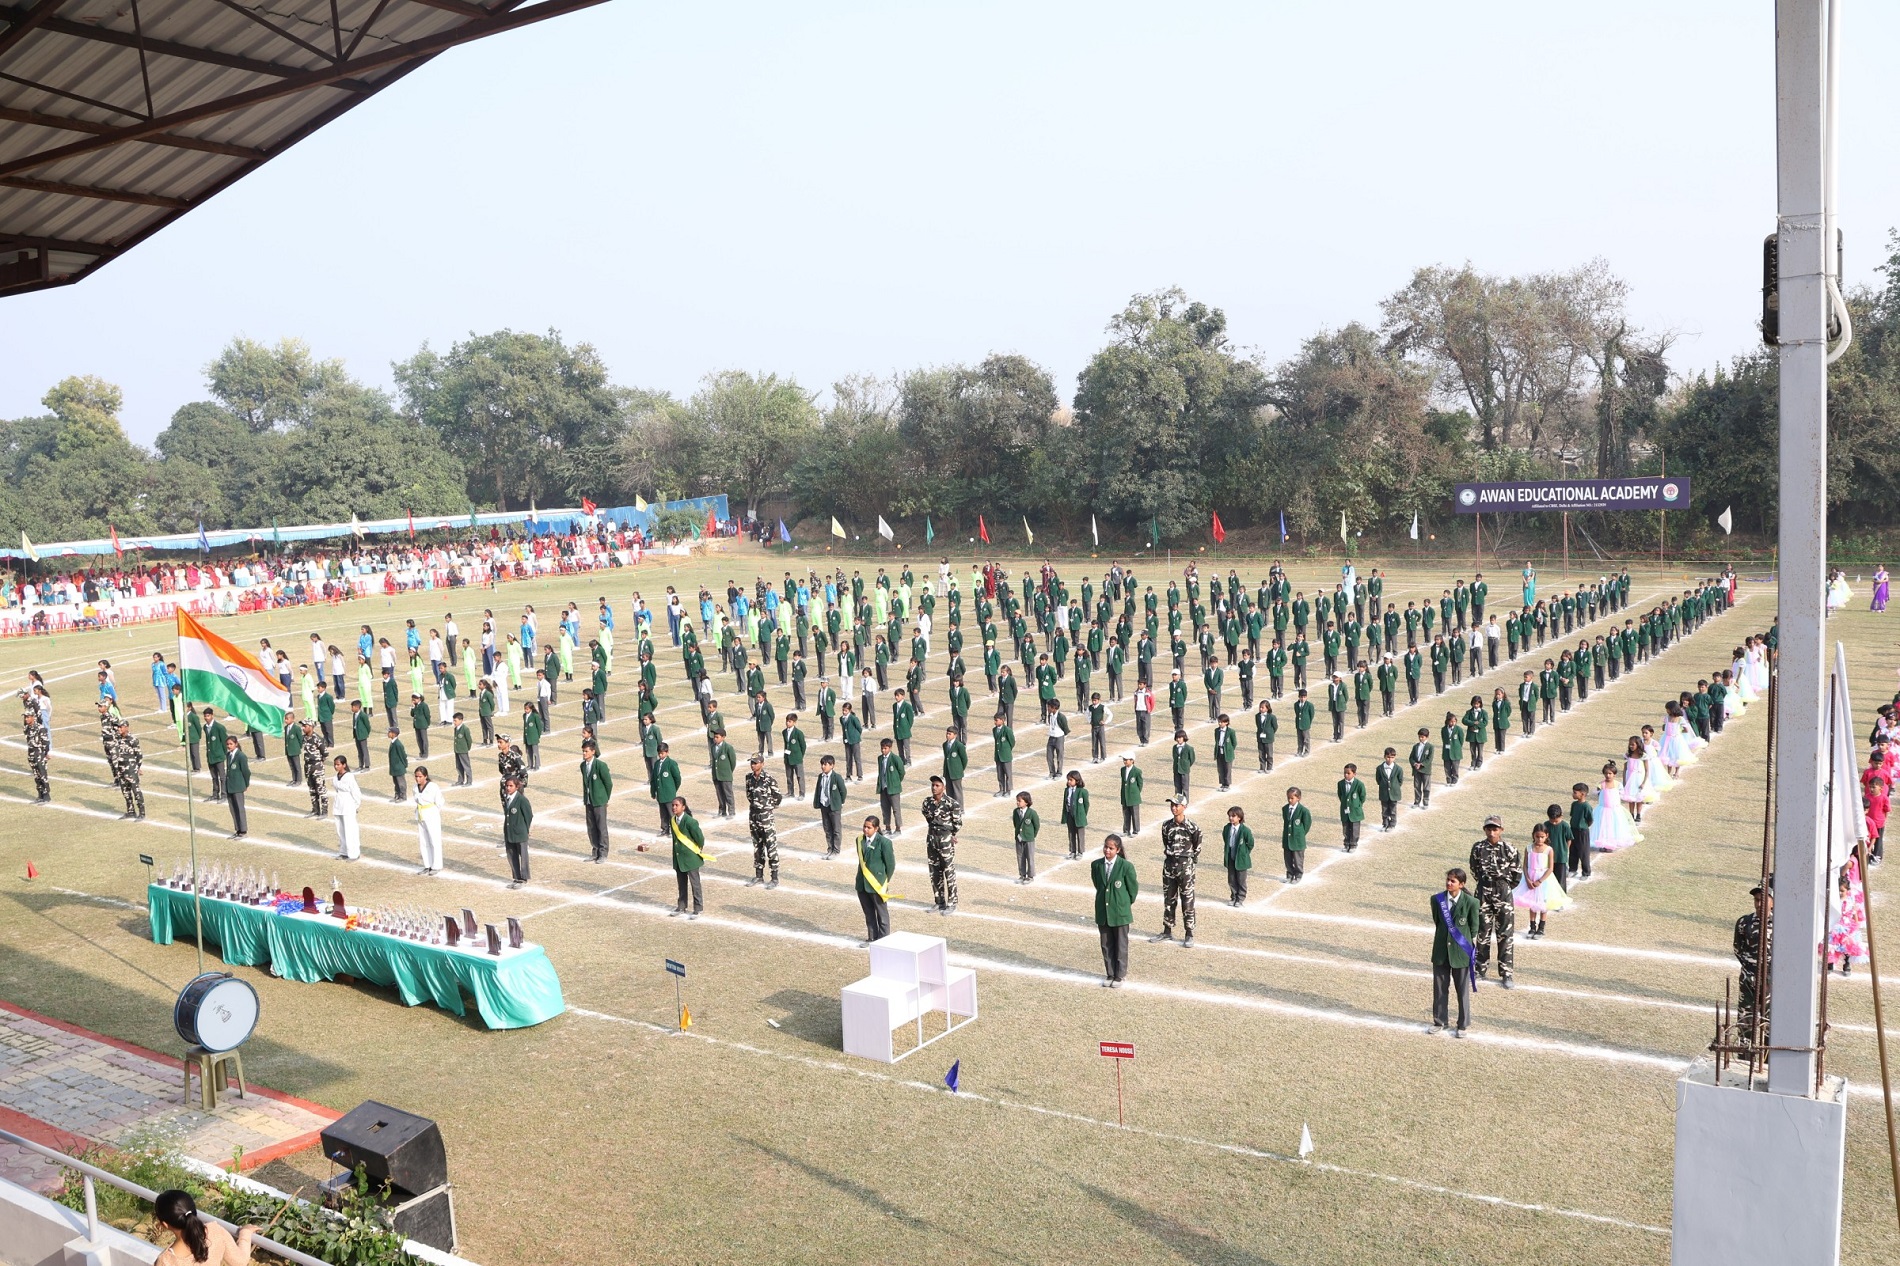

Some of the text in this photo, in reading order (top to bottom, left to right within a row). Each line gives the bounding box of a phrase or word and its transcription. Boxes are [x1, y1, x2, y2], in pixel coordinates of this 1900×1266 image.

[1480, 485, 1658, 503] AWAN EDUCATIONAL ACADEMY
